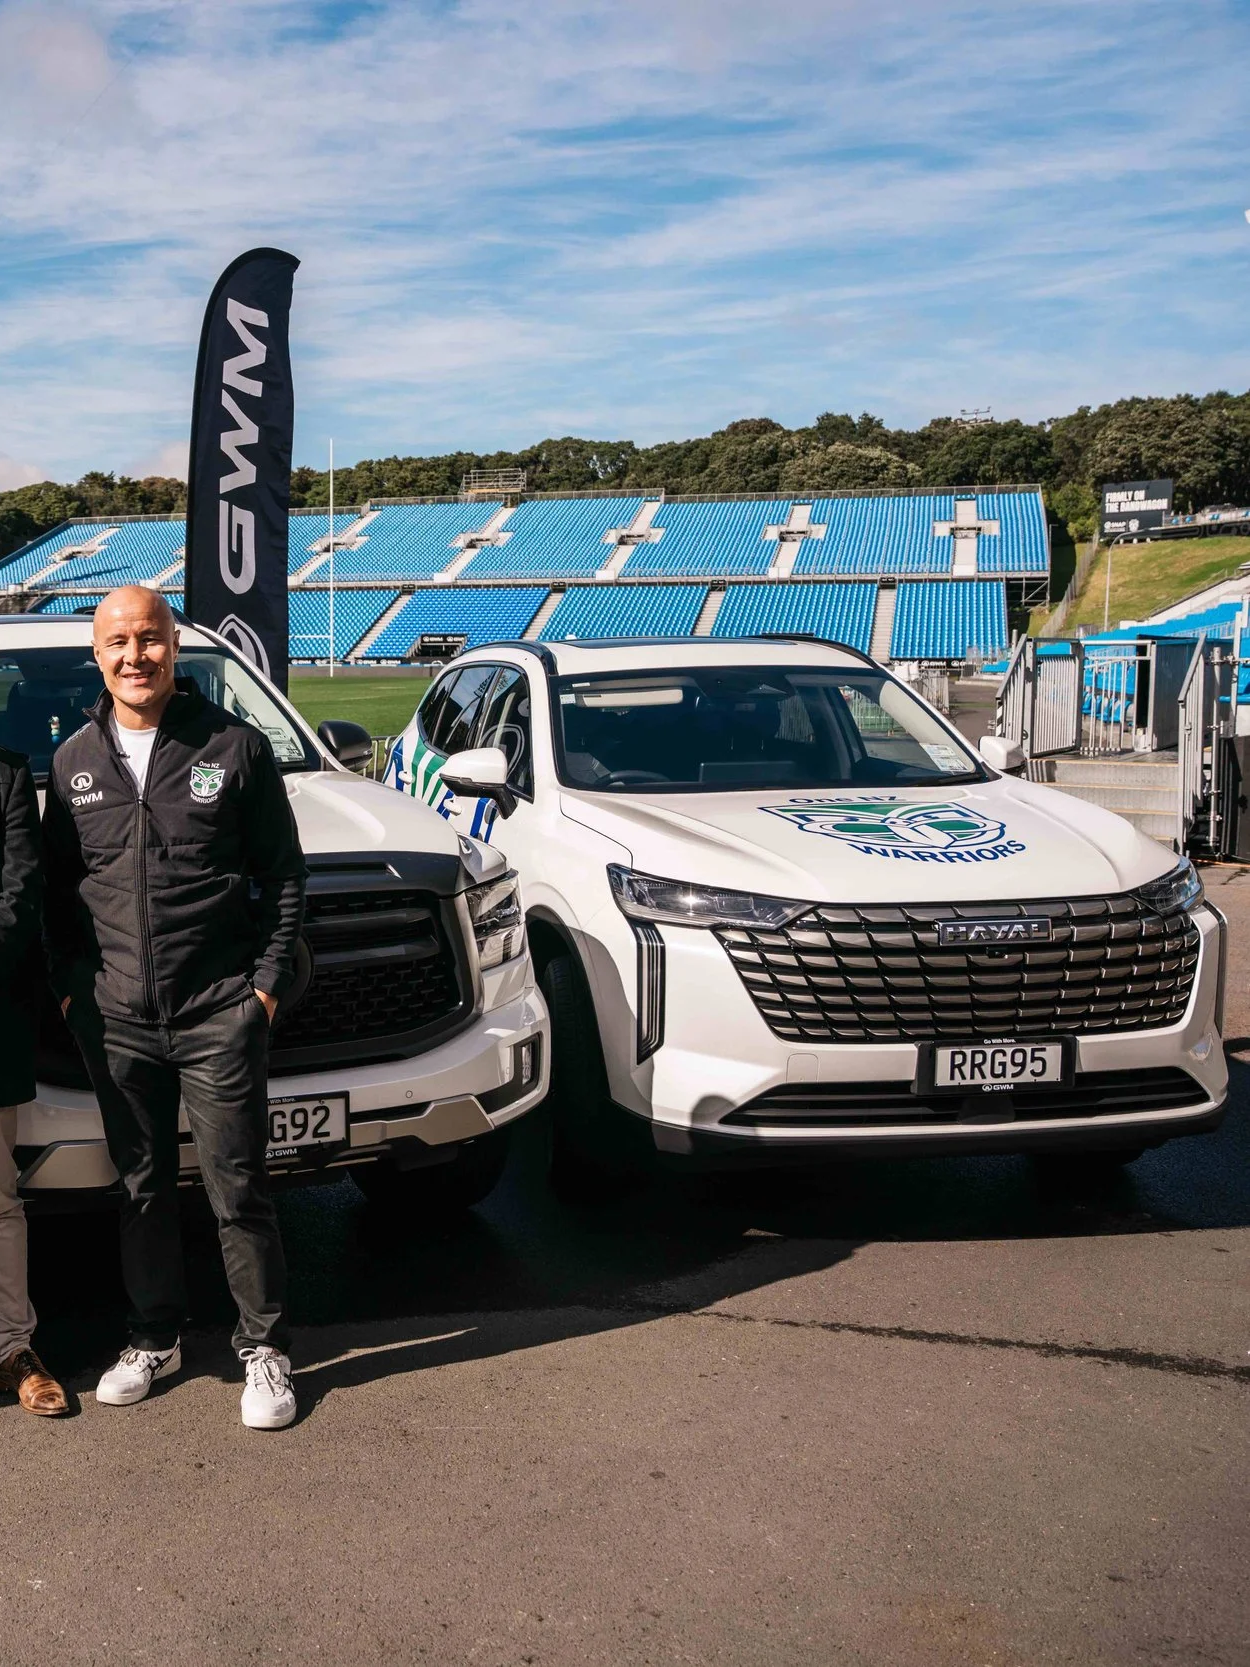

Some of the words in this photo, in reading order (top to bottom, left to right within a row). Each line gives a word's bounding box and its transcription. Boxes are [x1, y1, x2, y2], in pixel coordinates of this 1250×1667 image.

[219, 297, 269, 595] GWM
[1105, 502, 1120, 513] THE
[71, 791, 103, 807] GWM
[190, 791, 219, 804] WARRIORS
[788, 796, 858, 804] One
[847, 839, 1027, 864] WARRIORS
[946, 923, 1049, 942] HAVAL
[950, 1047, 1047, 1080] RRG95
[269, 1105, 331, 1143] G92
[275, 1148, 298, 1157] GWM
